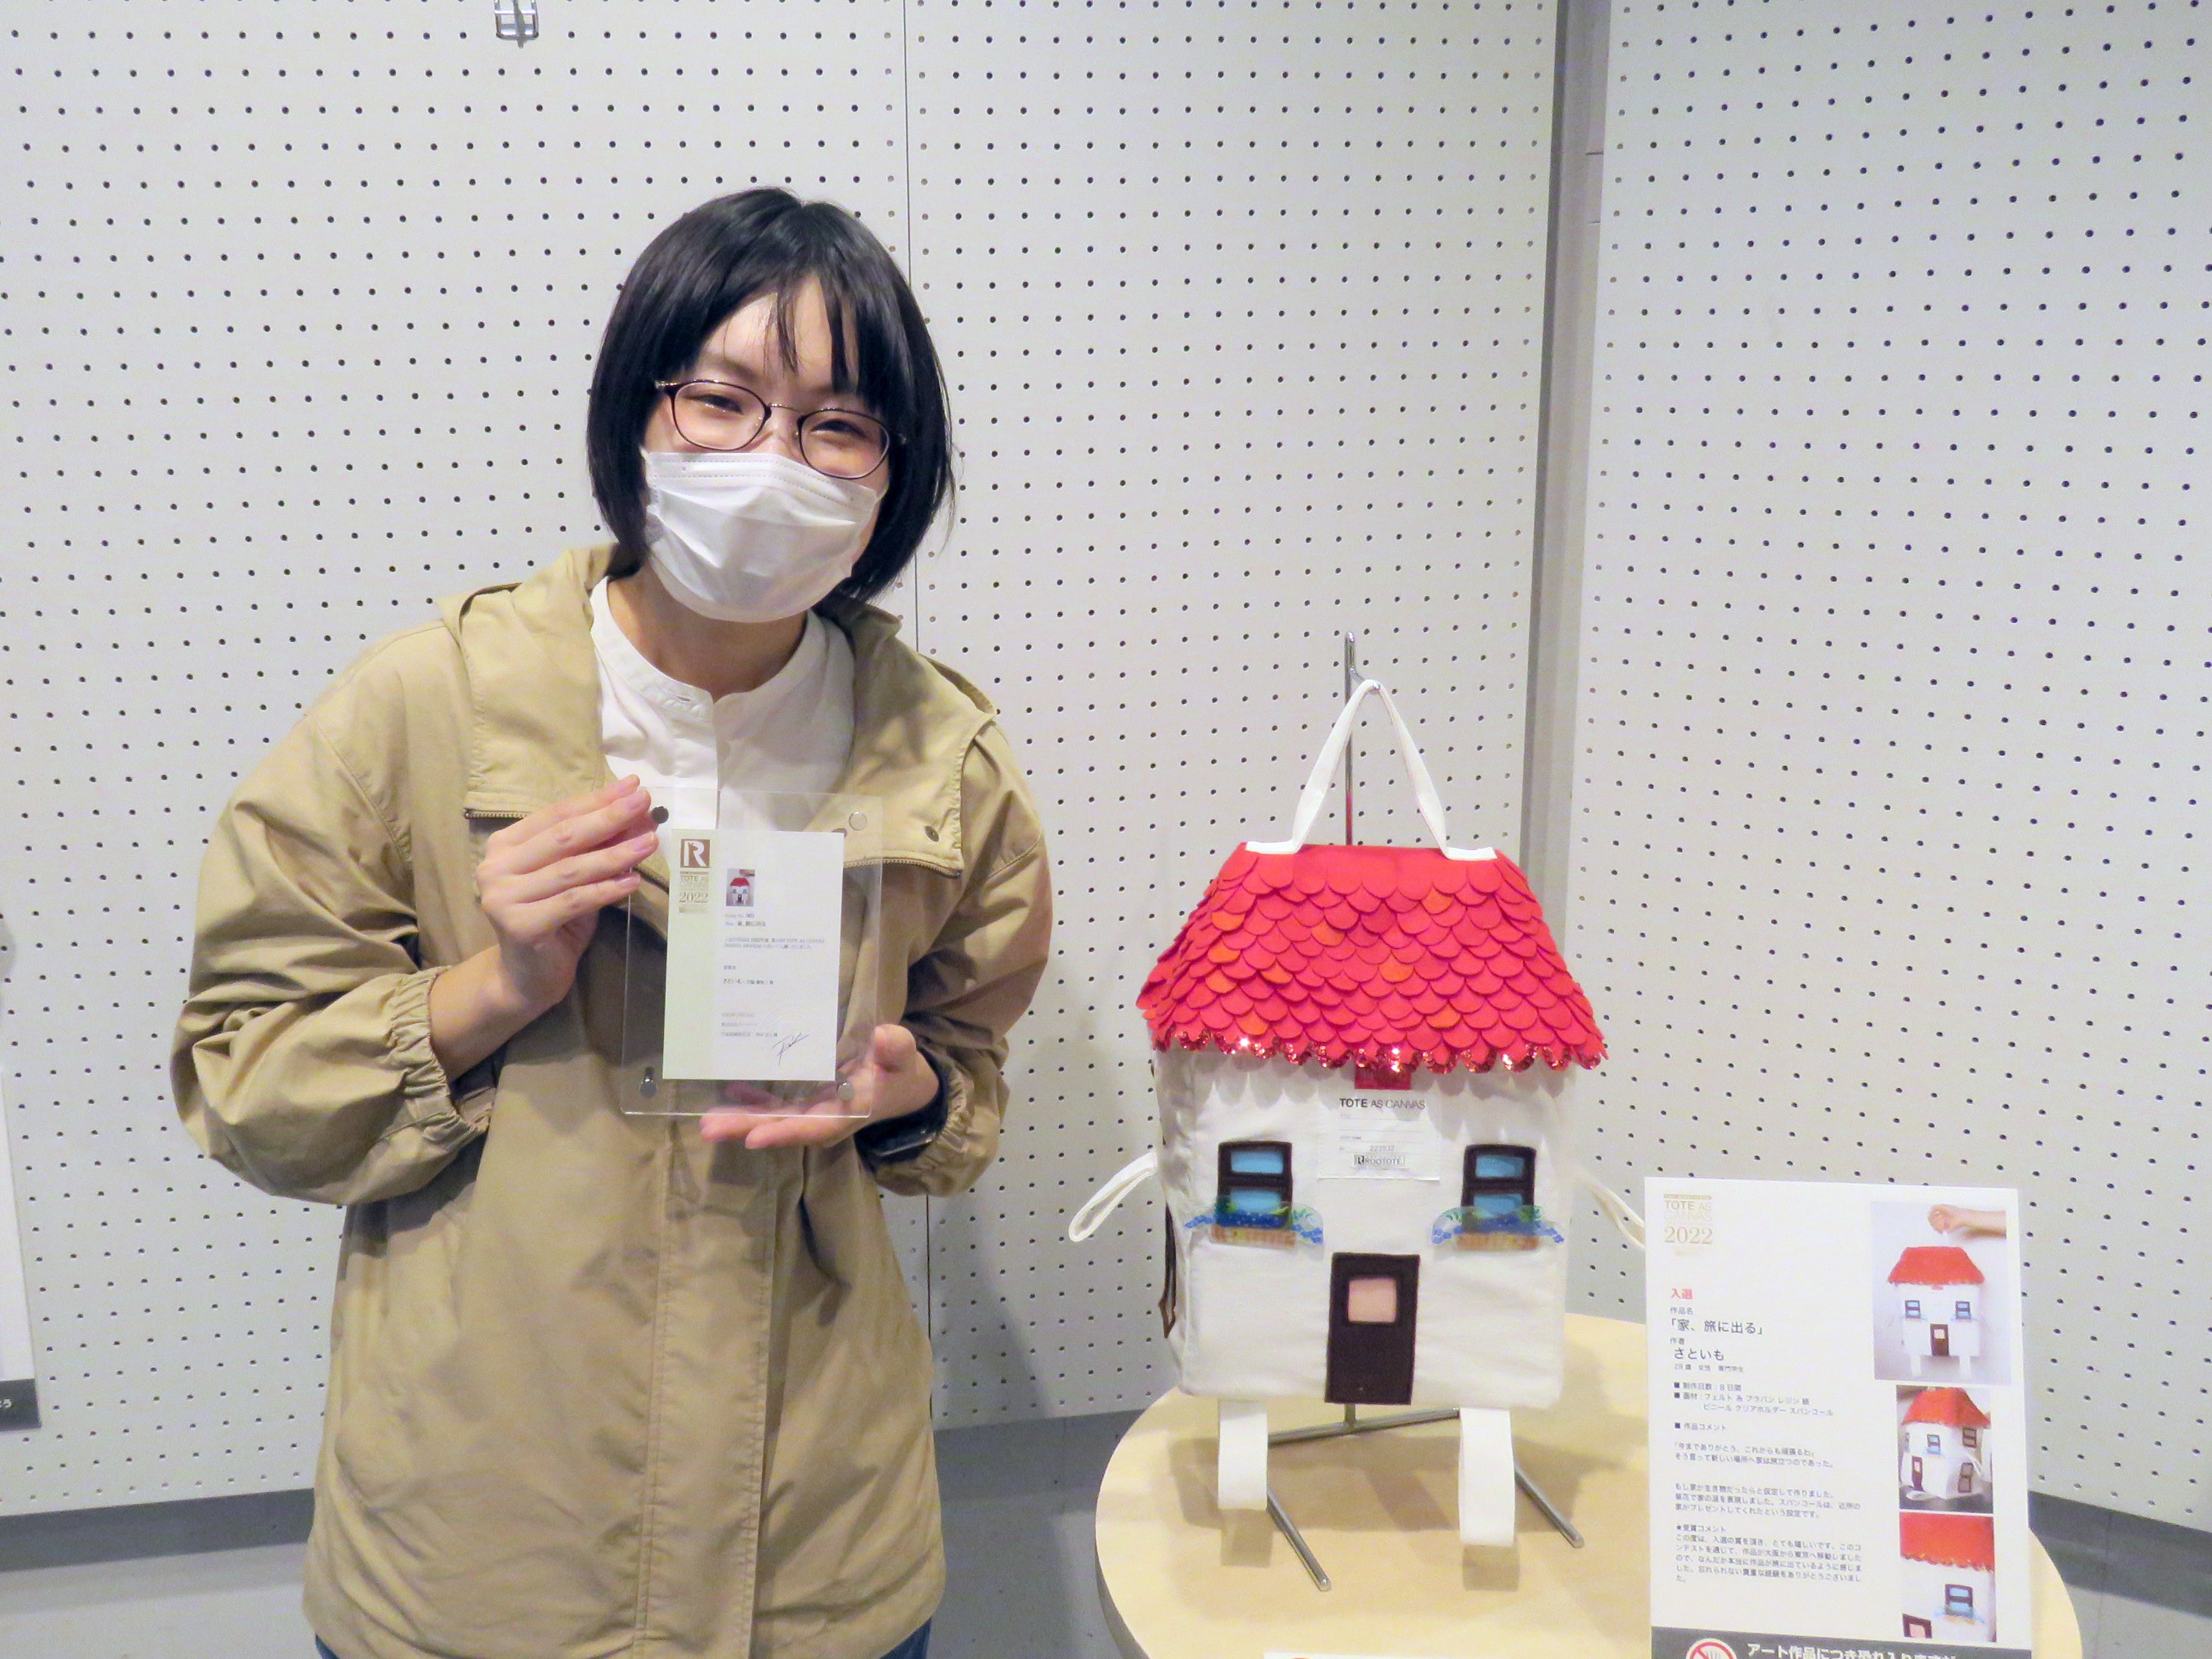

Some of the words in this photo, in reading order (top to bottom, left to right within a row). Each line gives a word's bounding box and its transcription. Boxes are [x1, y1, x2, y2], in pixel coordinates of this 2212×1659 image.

[683, 840, 708, 867] R
[679, 892, 708, 903] 2022
[1340, 1098, 1368, 1109] TOTE
[1371, 1099, 1383, 1109] AS
[1386, 1099, 1426, 1110] CANVAS
[1664, 1200, 1695, 1211] TOTE
[1699, 1202, 1712, 1211] AS
[1664, 1226, 1713, 1245] 2022
[1671, 1288, 1693, 1300] 入選
[1669, 1306, 1693, 1315] 作品名
[1671, 1318, 1763, 1335] 「家、旅に出る」
[1674, 1347, 1724, 1361] さといも
[1684, 1422, 1727, 1431] 作品コメント
